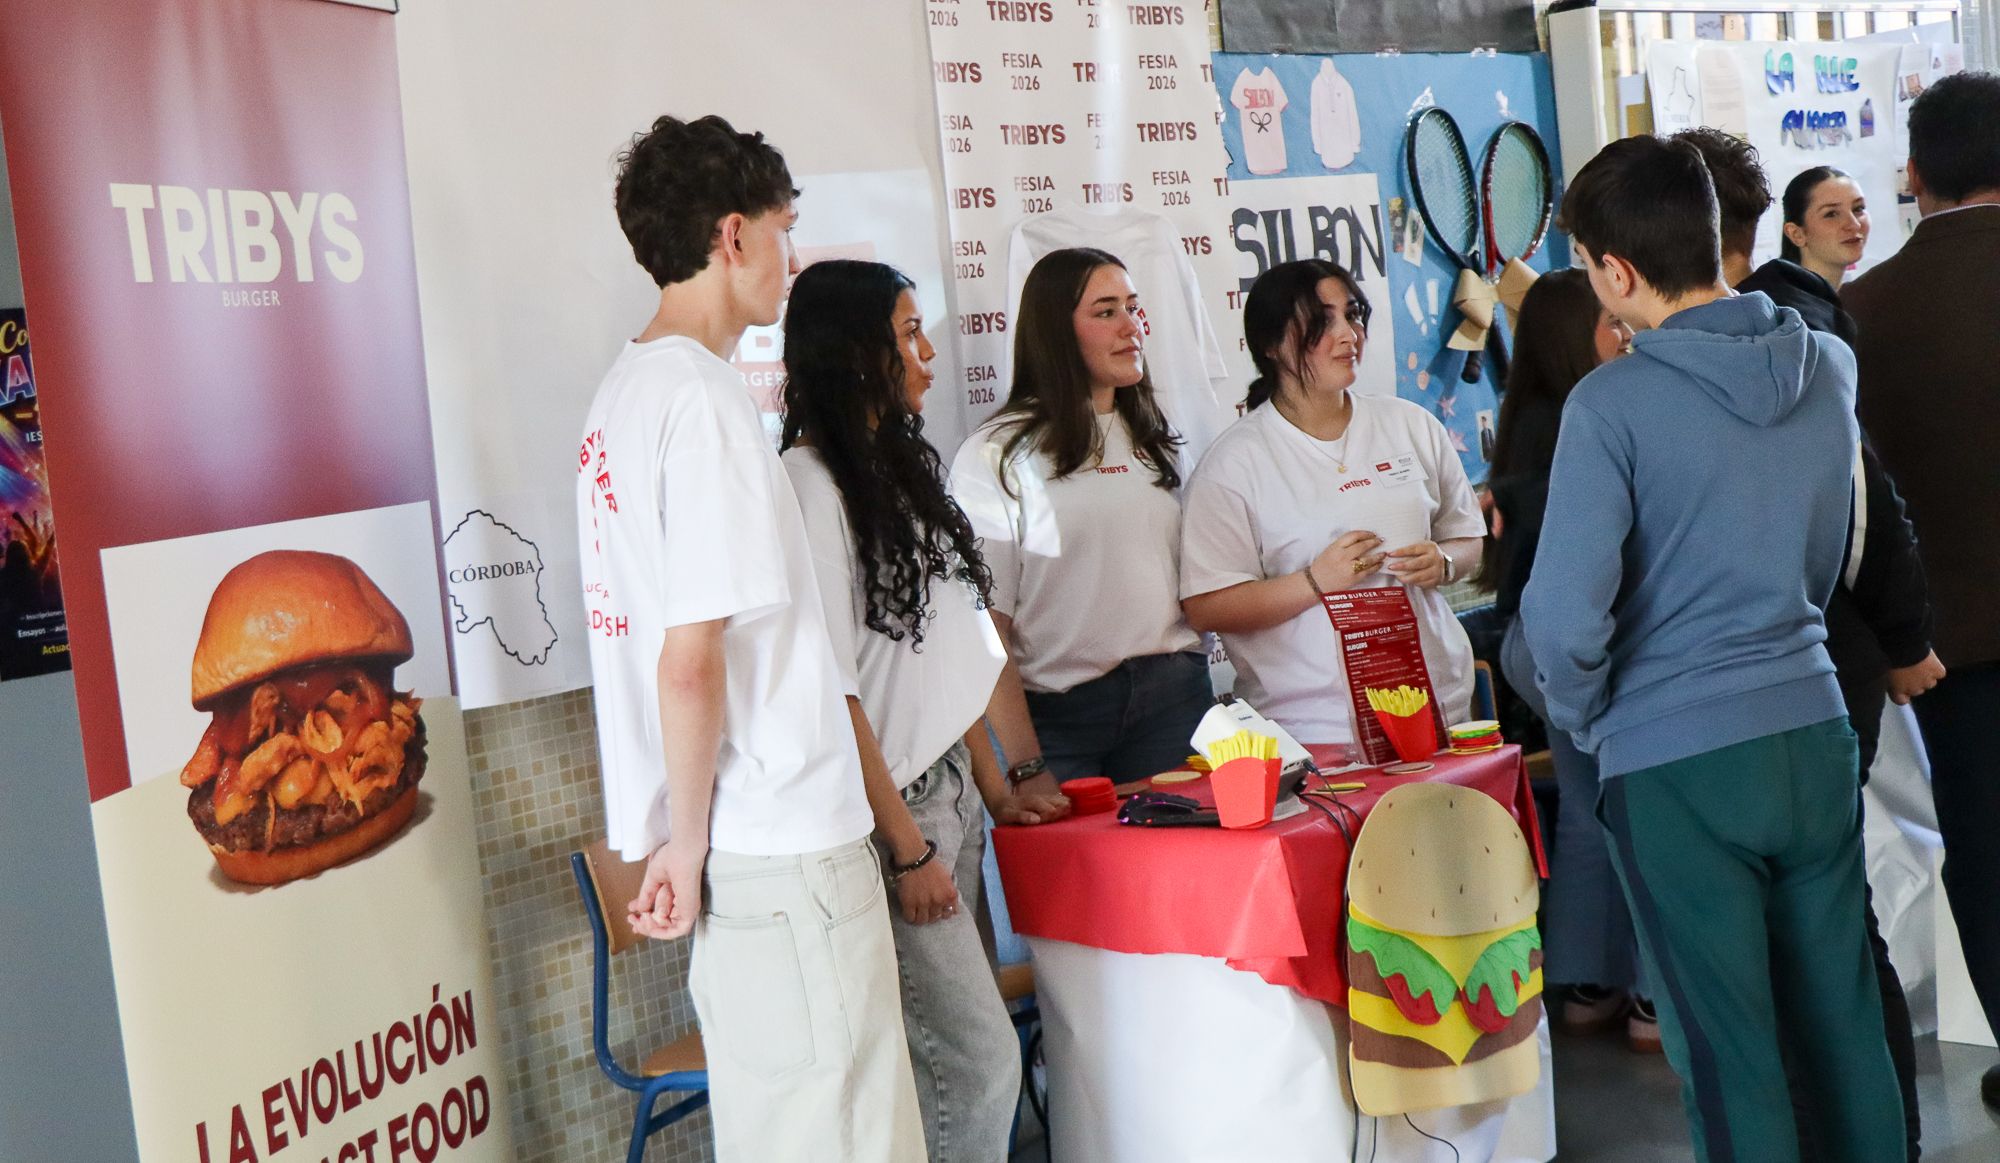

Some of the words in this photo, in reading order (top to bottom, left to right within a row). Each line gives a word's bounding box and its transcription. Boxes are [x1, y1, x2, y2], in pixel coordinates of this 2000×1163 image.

[930, 10, 958, 27] 2026
[987, 0, 1053, 22] TRIBYS
[1127, 5, 1184, 25] TRIBYS
[1002, 52, 1042, 69] FESIA
[1138, 54, 1178, 70] FESIA
[1011, 75, 1040, 91] 2026
[1147, 75, 1176, 90] 2026
[1000, 123, 1066, 145] TRIBYS
[1137, 121, 1197, 142] TRIBYS
[1014, 175, 1055, 191] FESIA
[1152, 170, 1191, 186] FESIA
[1082, 183, 1134, 204] TRIBYS
[1162, 191, 1191, 206] 2026
[1021, 198, 1053, 213] 2026
[110, 183, 364, 283] TRIBYS
[956, 263, 985, 279] 2026
[222, 290, 281, 308] BURGER
[968, 388, 996, 405] 2026
[1096, 464, 1129, 475] TRIBYS
[1338, 478, 1372, 493] TRIBYS
[449, 559, 535, 584] CÓRDOBA
[1348, 591, 1378, 600] BURGER
[17, 627, 46, 638] Ensayos
[1365, 626, 1392, 637] BURGER
[262, 983, 477, 1155] EVOLUCIÓN
[388, 1074, 490, 1163] FOOD
